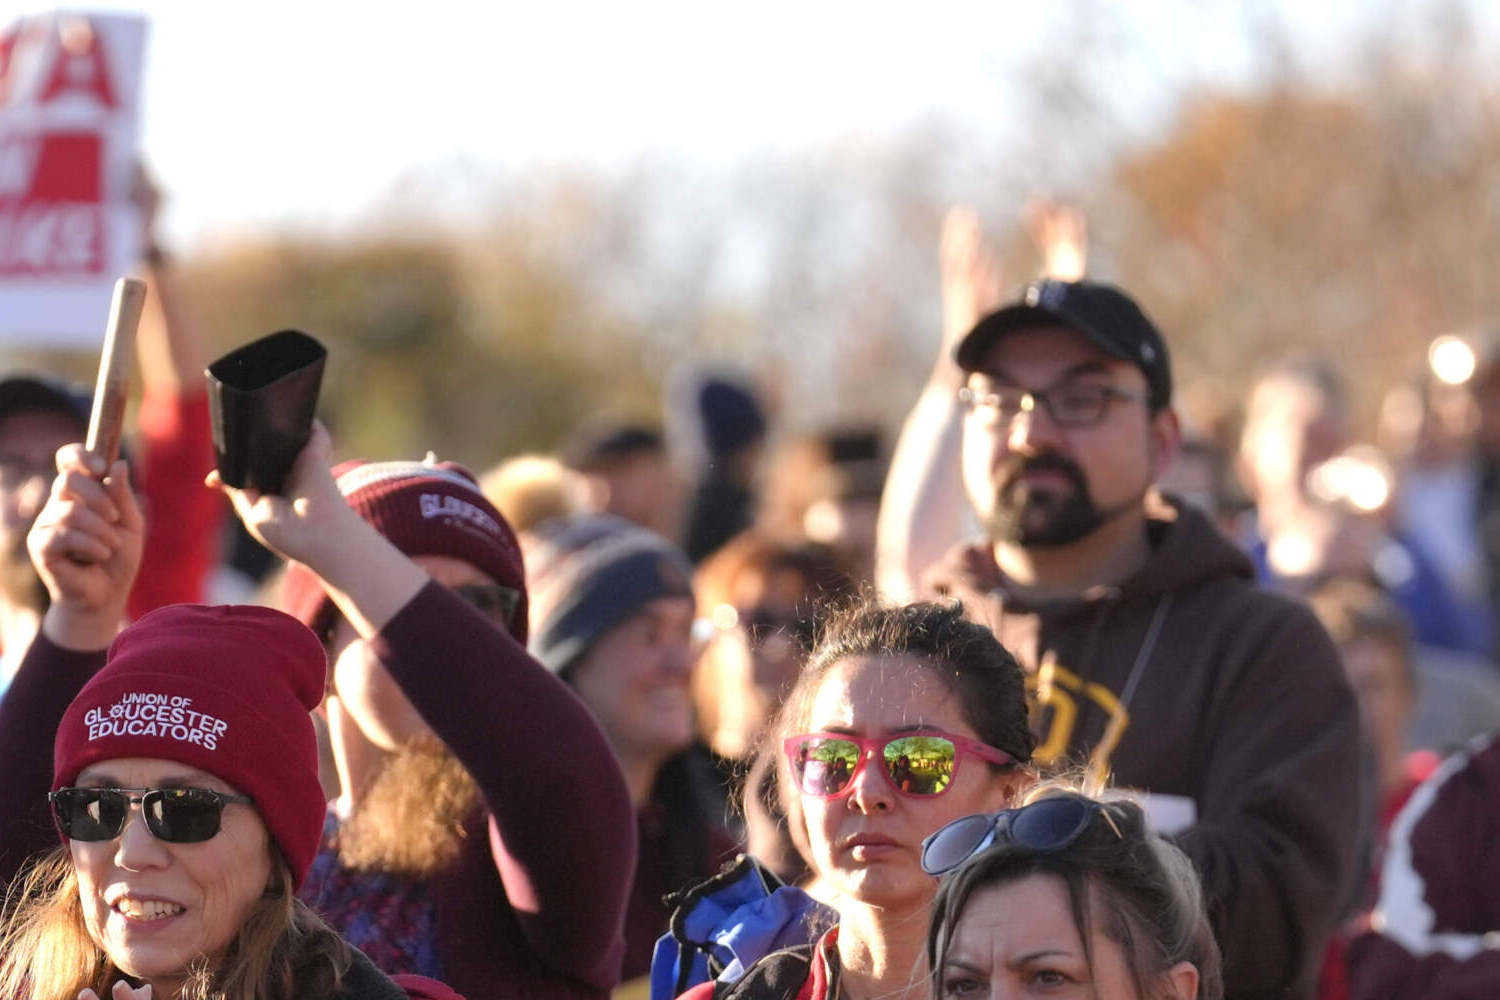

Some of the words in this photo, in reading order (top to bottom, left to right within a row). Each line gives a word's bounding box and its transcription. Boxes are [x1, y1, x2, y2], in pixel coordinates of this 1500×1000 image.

[122, 692, 168, 706] UNION
[170, 695, 193, 709] OF
[84, 704, 228, 738] GLOUCESTER
[88, 720, 218, 751] EDUCATORS
